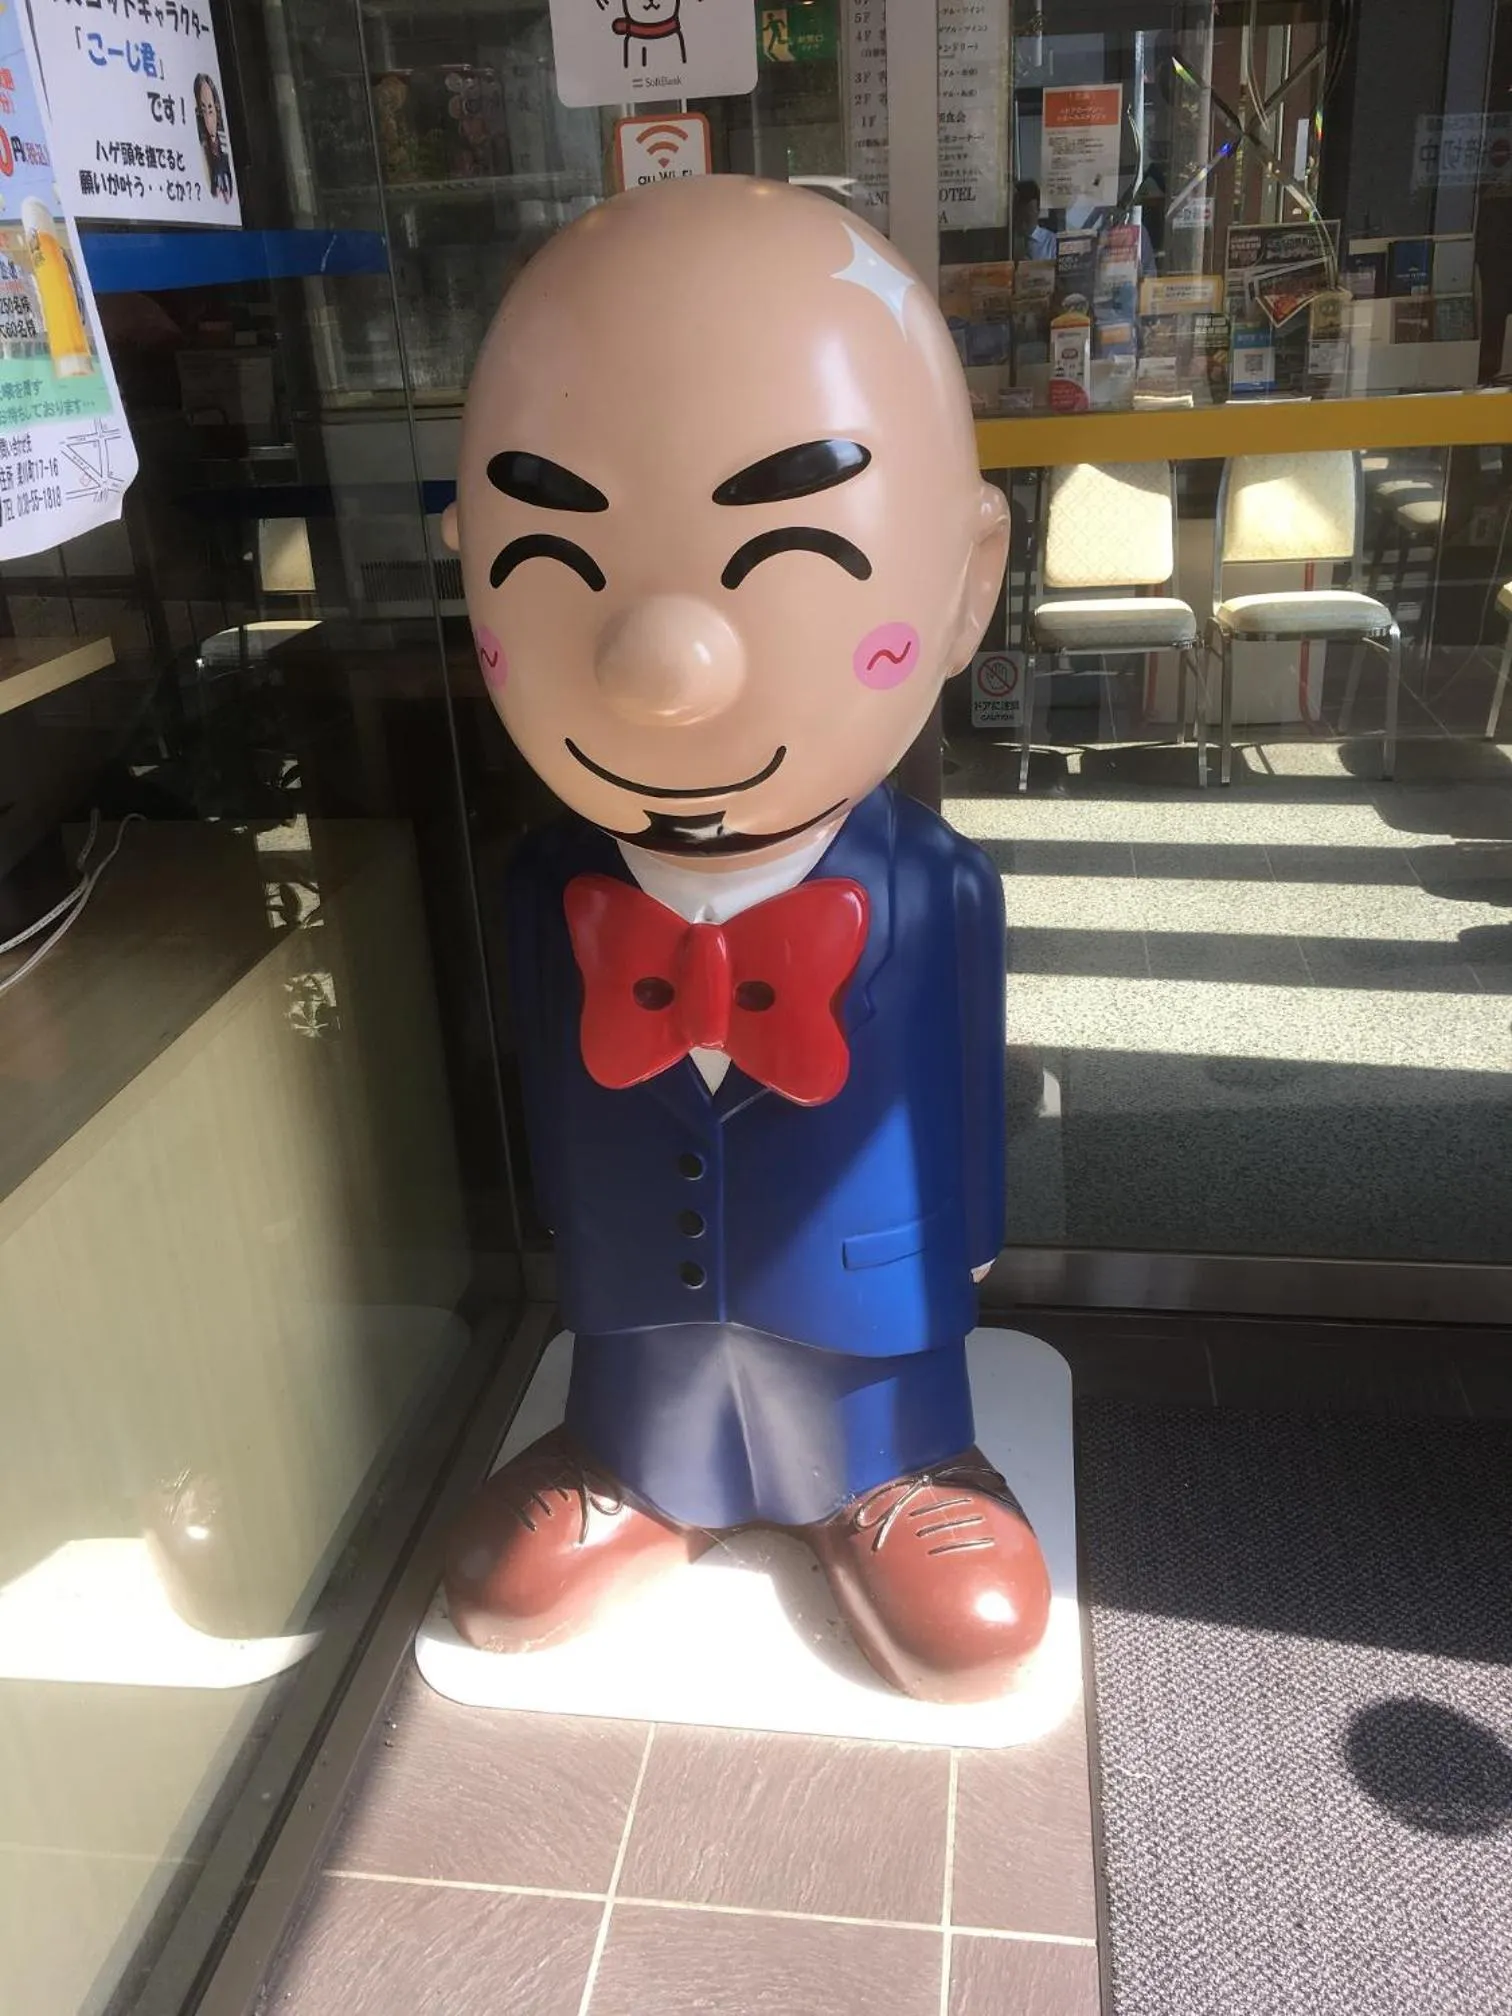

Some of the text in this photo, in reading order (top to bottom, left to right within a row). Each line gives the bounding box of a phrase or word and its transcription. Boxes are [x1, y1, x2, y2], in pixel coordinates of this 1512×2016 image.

[52, 0, 210, 39] ットキャラクター
[74, 25, 165, 81] 「こーじ君」
[645, 76, 682, 88] SoftBank
[147, 91, 187, 125] です！
[938, 186, 977, 202] OTEL
